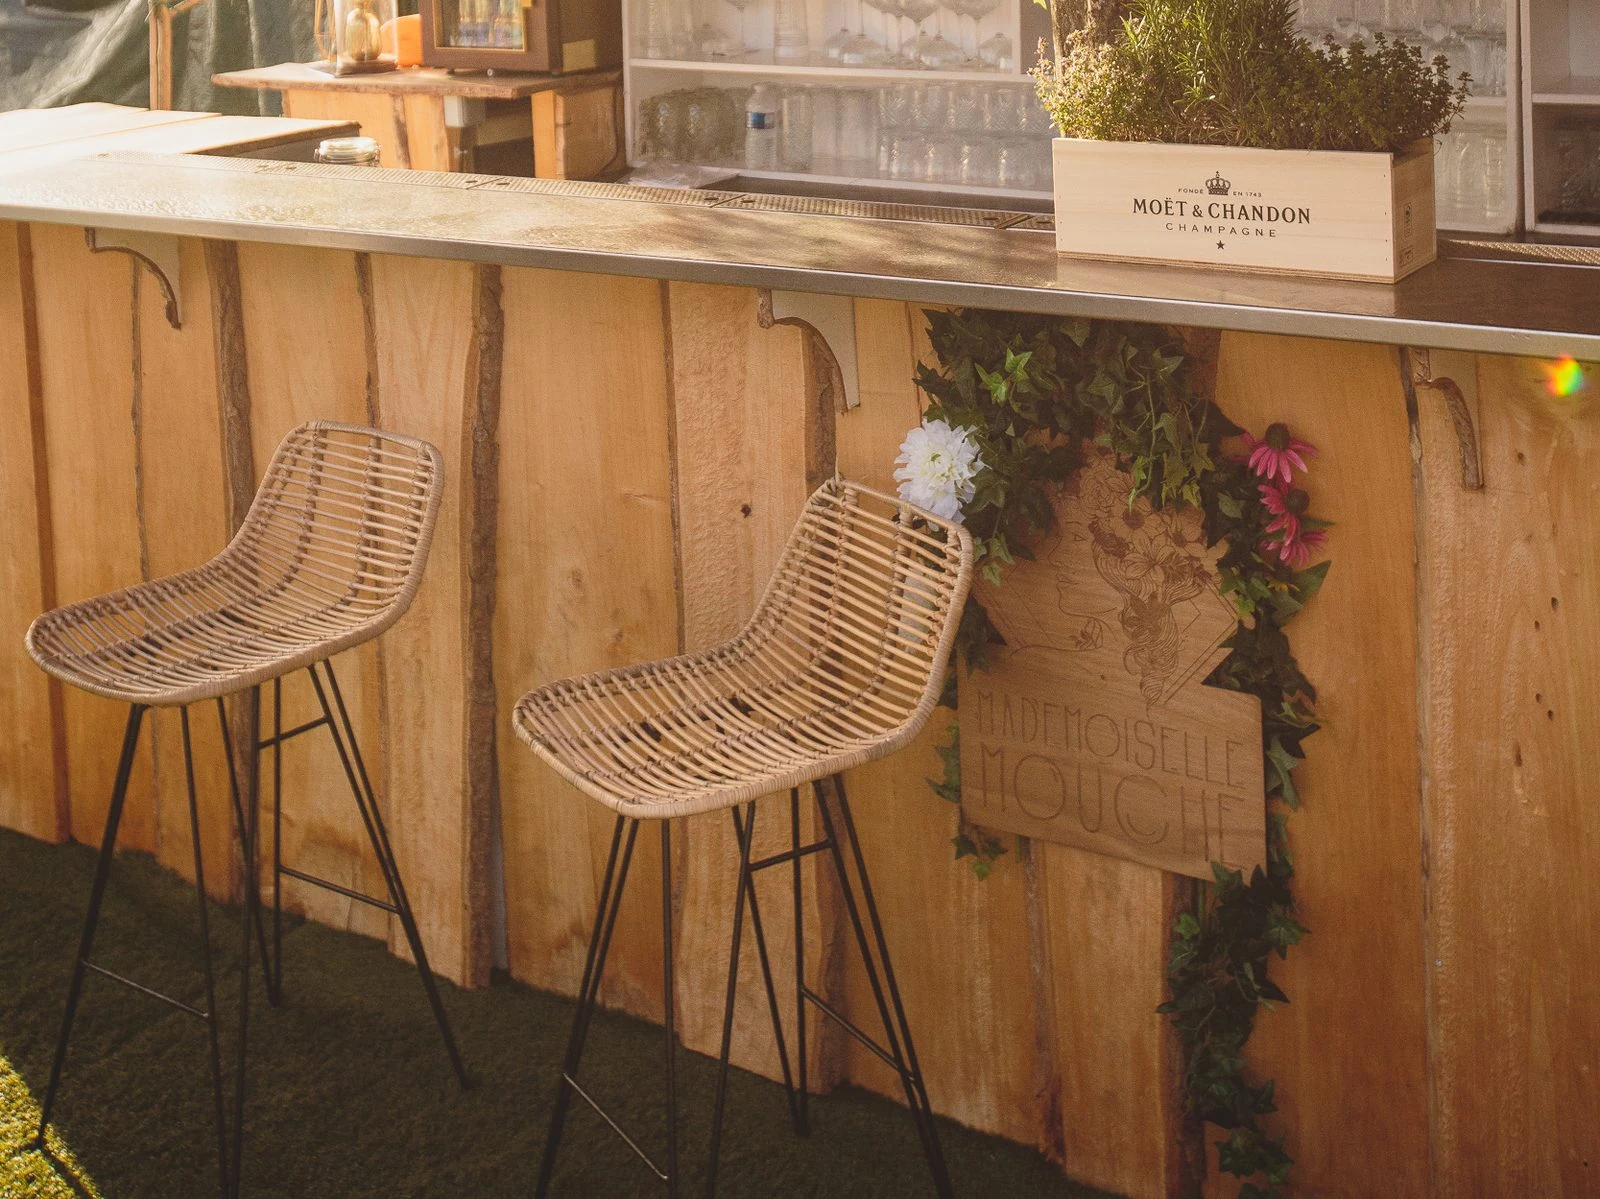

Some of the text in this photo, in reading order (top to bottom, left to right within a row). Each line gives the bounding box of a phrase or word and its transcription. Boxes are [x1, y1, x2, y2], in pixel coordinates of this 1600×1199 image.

[1133, 197, 1311, 224] MOËT & CHANDON
[1165, 222, 1277, 238] CHAMPAGNE
[977, 689, 1246, 790] MADEMOISELLE
[980, 740, 1247, 872] MOUCHE
